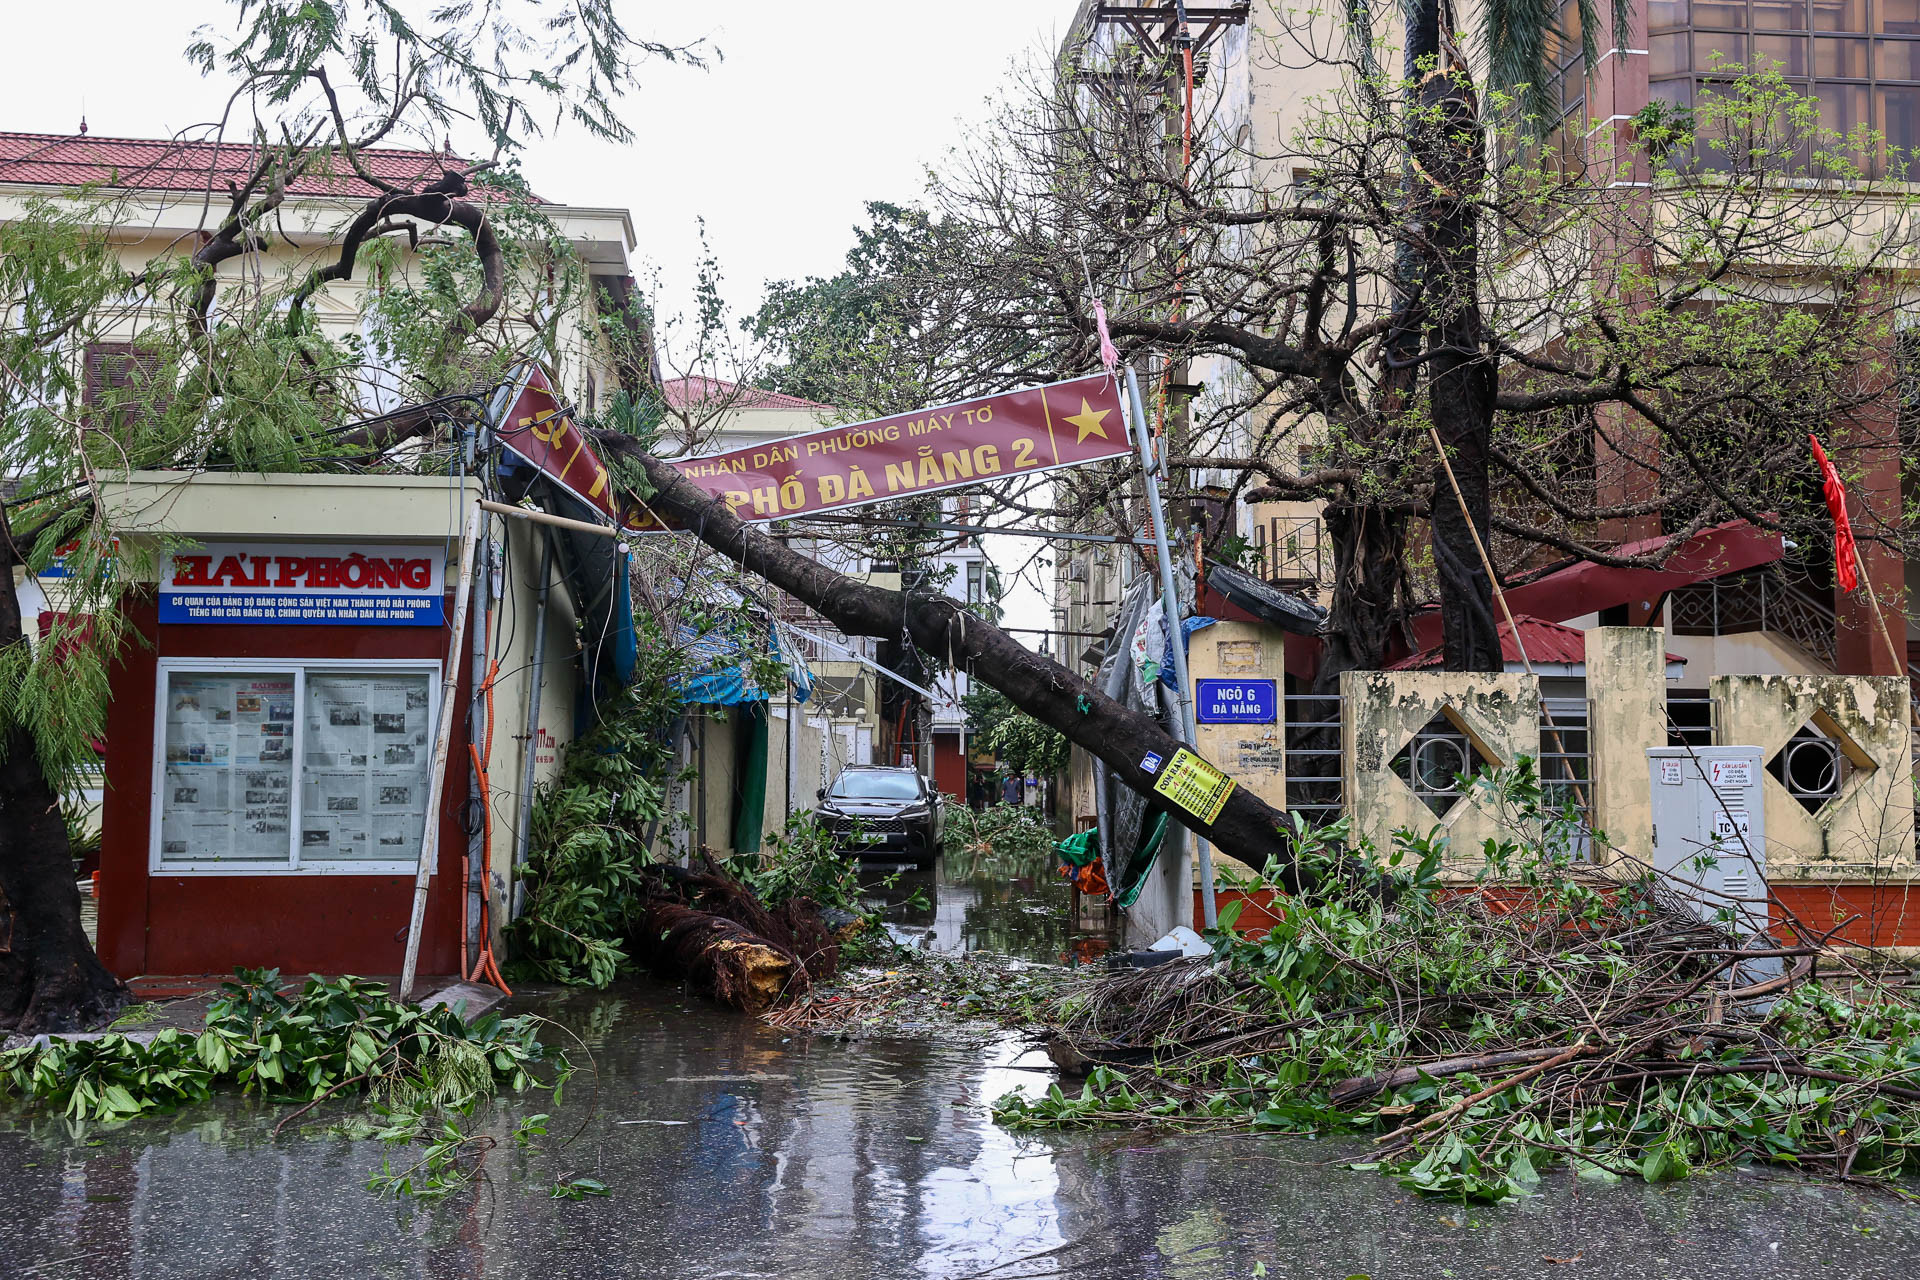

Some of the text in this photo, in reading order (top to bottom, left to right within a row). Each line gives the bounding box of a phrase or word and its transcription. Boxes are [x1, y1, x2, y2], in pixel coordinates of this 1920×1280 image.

[684, 404, 993, 479] NHÂN DÂN PHƯỜNG MÁY TƠ
[723, 469, 806, 516] PHỐ
[817, 464, 875, 505] ĐÀ
[884, 444, 1002, 492] NẴNG
[1011, 438, 1038, 469] 2
[172, 595, 431, 609] CƠ QUAN CỦA ĐẢNG BỘ ĐẢNG CỘNG SẢN VIỆT NAM THÀNH PHỐ HẢI PHÒNG
[188, 607, 210, 617] TIẾNG
[211, 607, 225, 617] NÓI
[226, 607, 242, 617] CỦA
[242, 607, 263, 618] ĐẢNG
[278, 608, 301, 618] CHÍNH
[302, 608, 326, 619] QUYỀN
[327, 609, 337, 618] VÀ
[338, 609, 359, 619] NHÂN
[360, 609, 375, 619] DÂN
[375, 609, 389, 619] HẢI
[390, 609, 415, 619] PHÒNG
[1217, 685, 1256, 701] NGÕ 6
[1212, 701, 1261, 714] ĐÀ NẴNG
[1144, 756, 1159, 769] 04
[1159, 753, 1188, 791] CƠM RANG
[1719, 823, 1731, 833] TC
